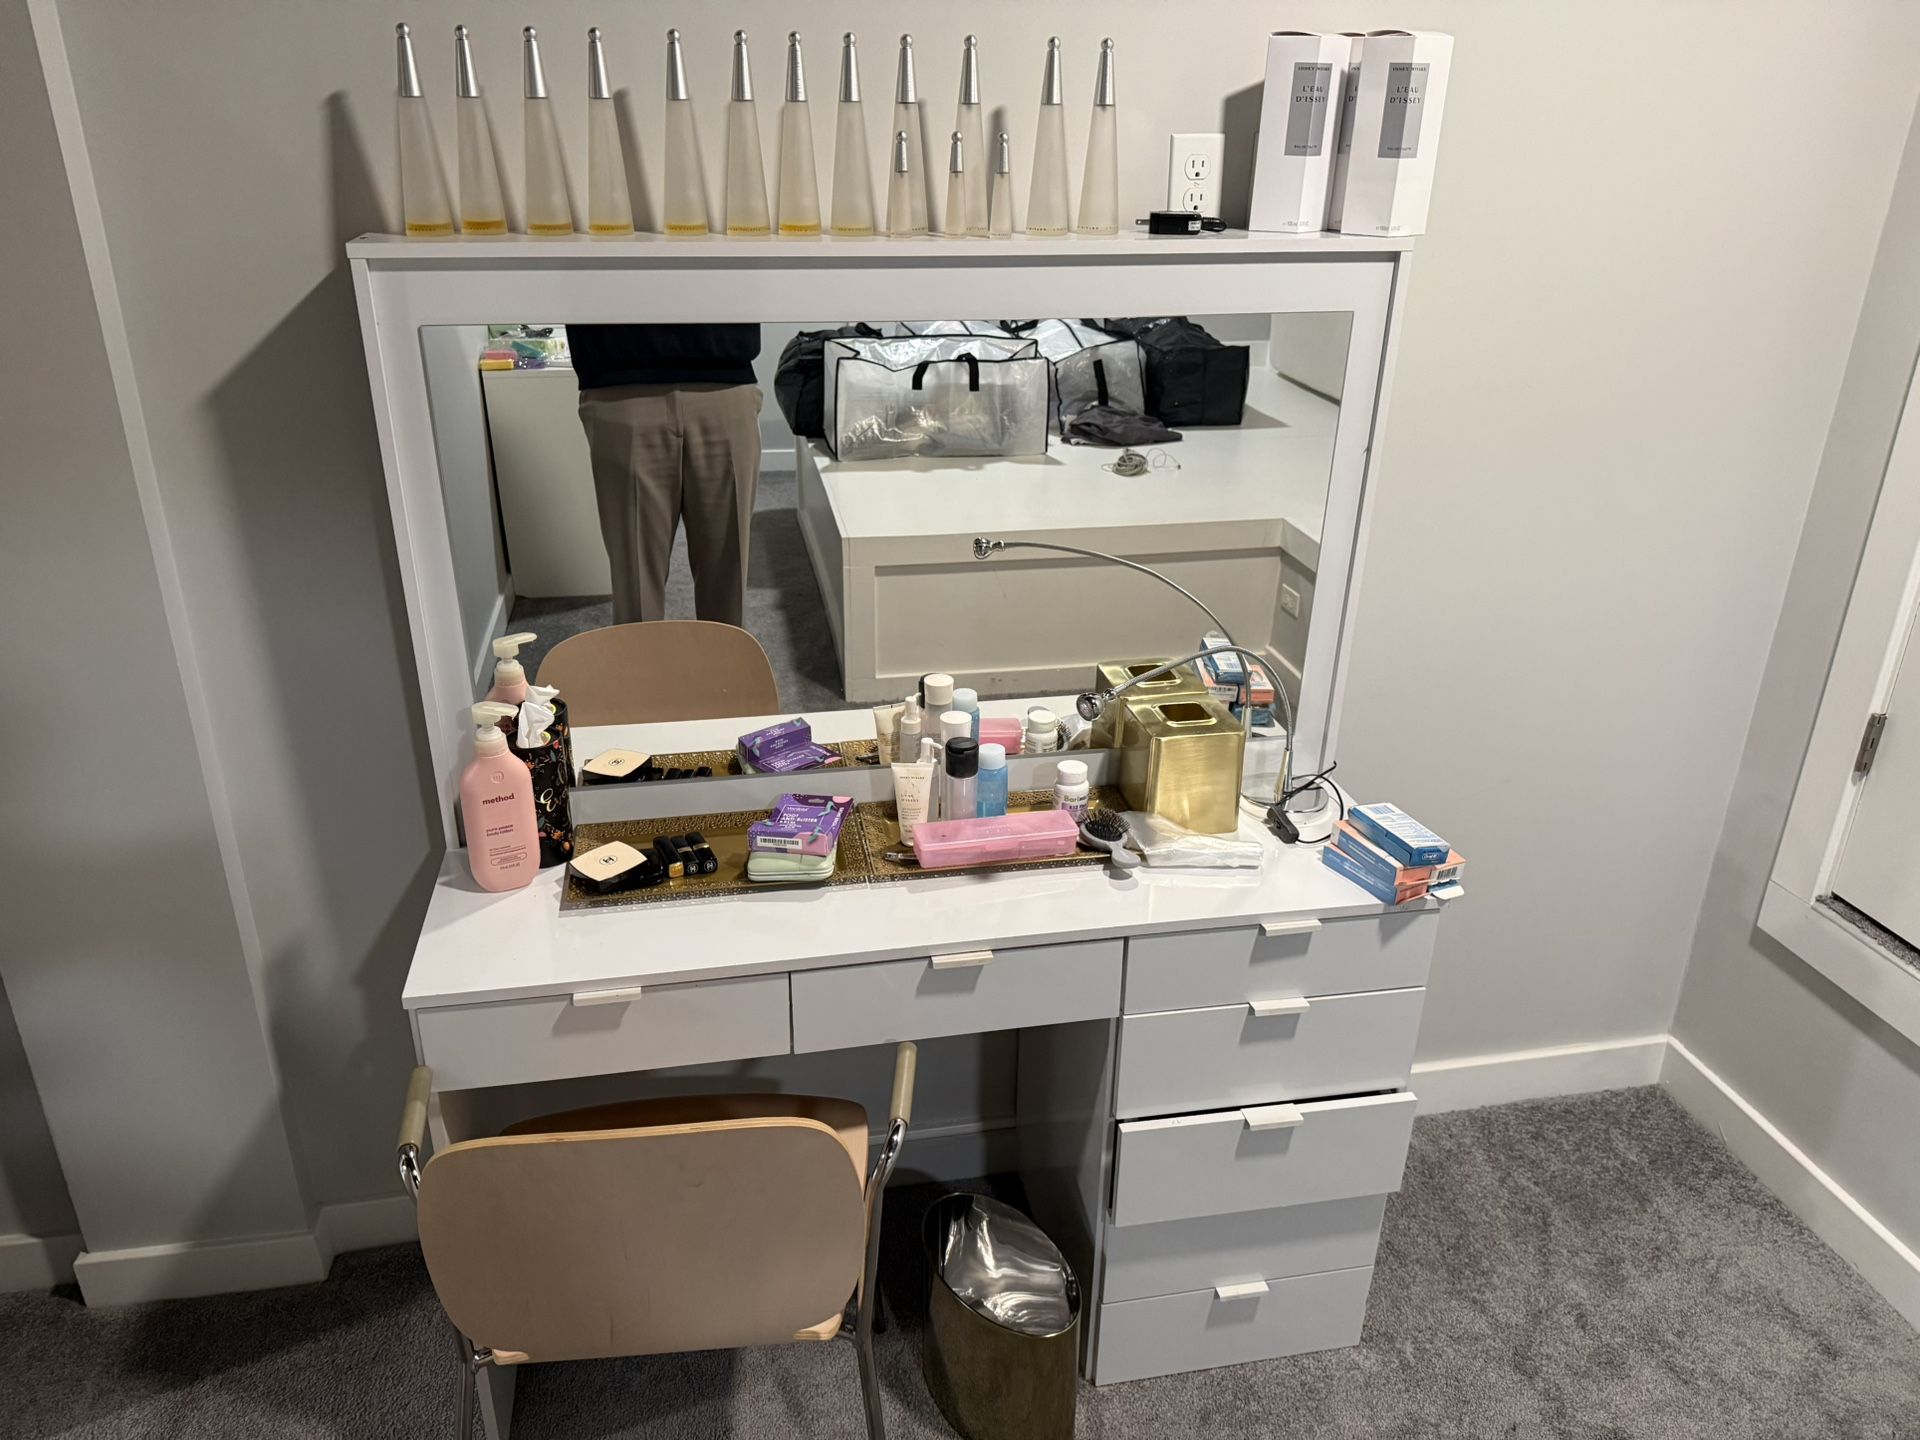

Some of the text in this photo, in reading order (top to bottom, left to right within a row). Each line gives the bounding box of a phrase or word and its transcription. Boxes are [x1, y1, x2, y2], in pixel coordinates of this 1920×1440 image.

[1302, 85, 1323, 93] L'EAU
[1396, 86, 1419, 94] L'EAU
[1295, 95, 1325, 103] D'ISSEY
[1389, 96, 1422, 104] D'ISSEY
[482, 793, 515, 805] method
